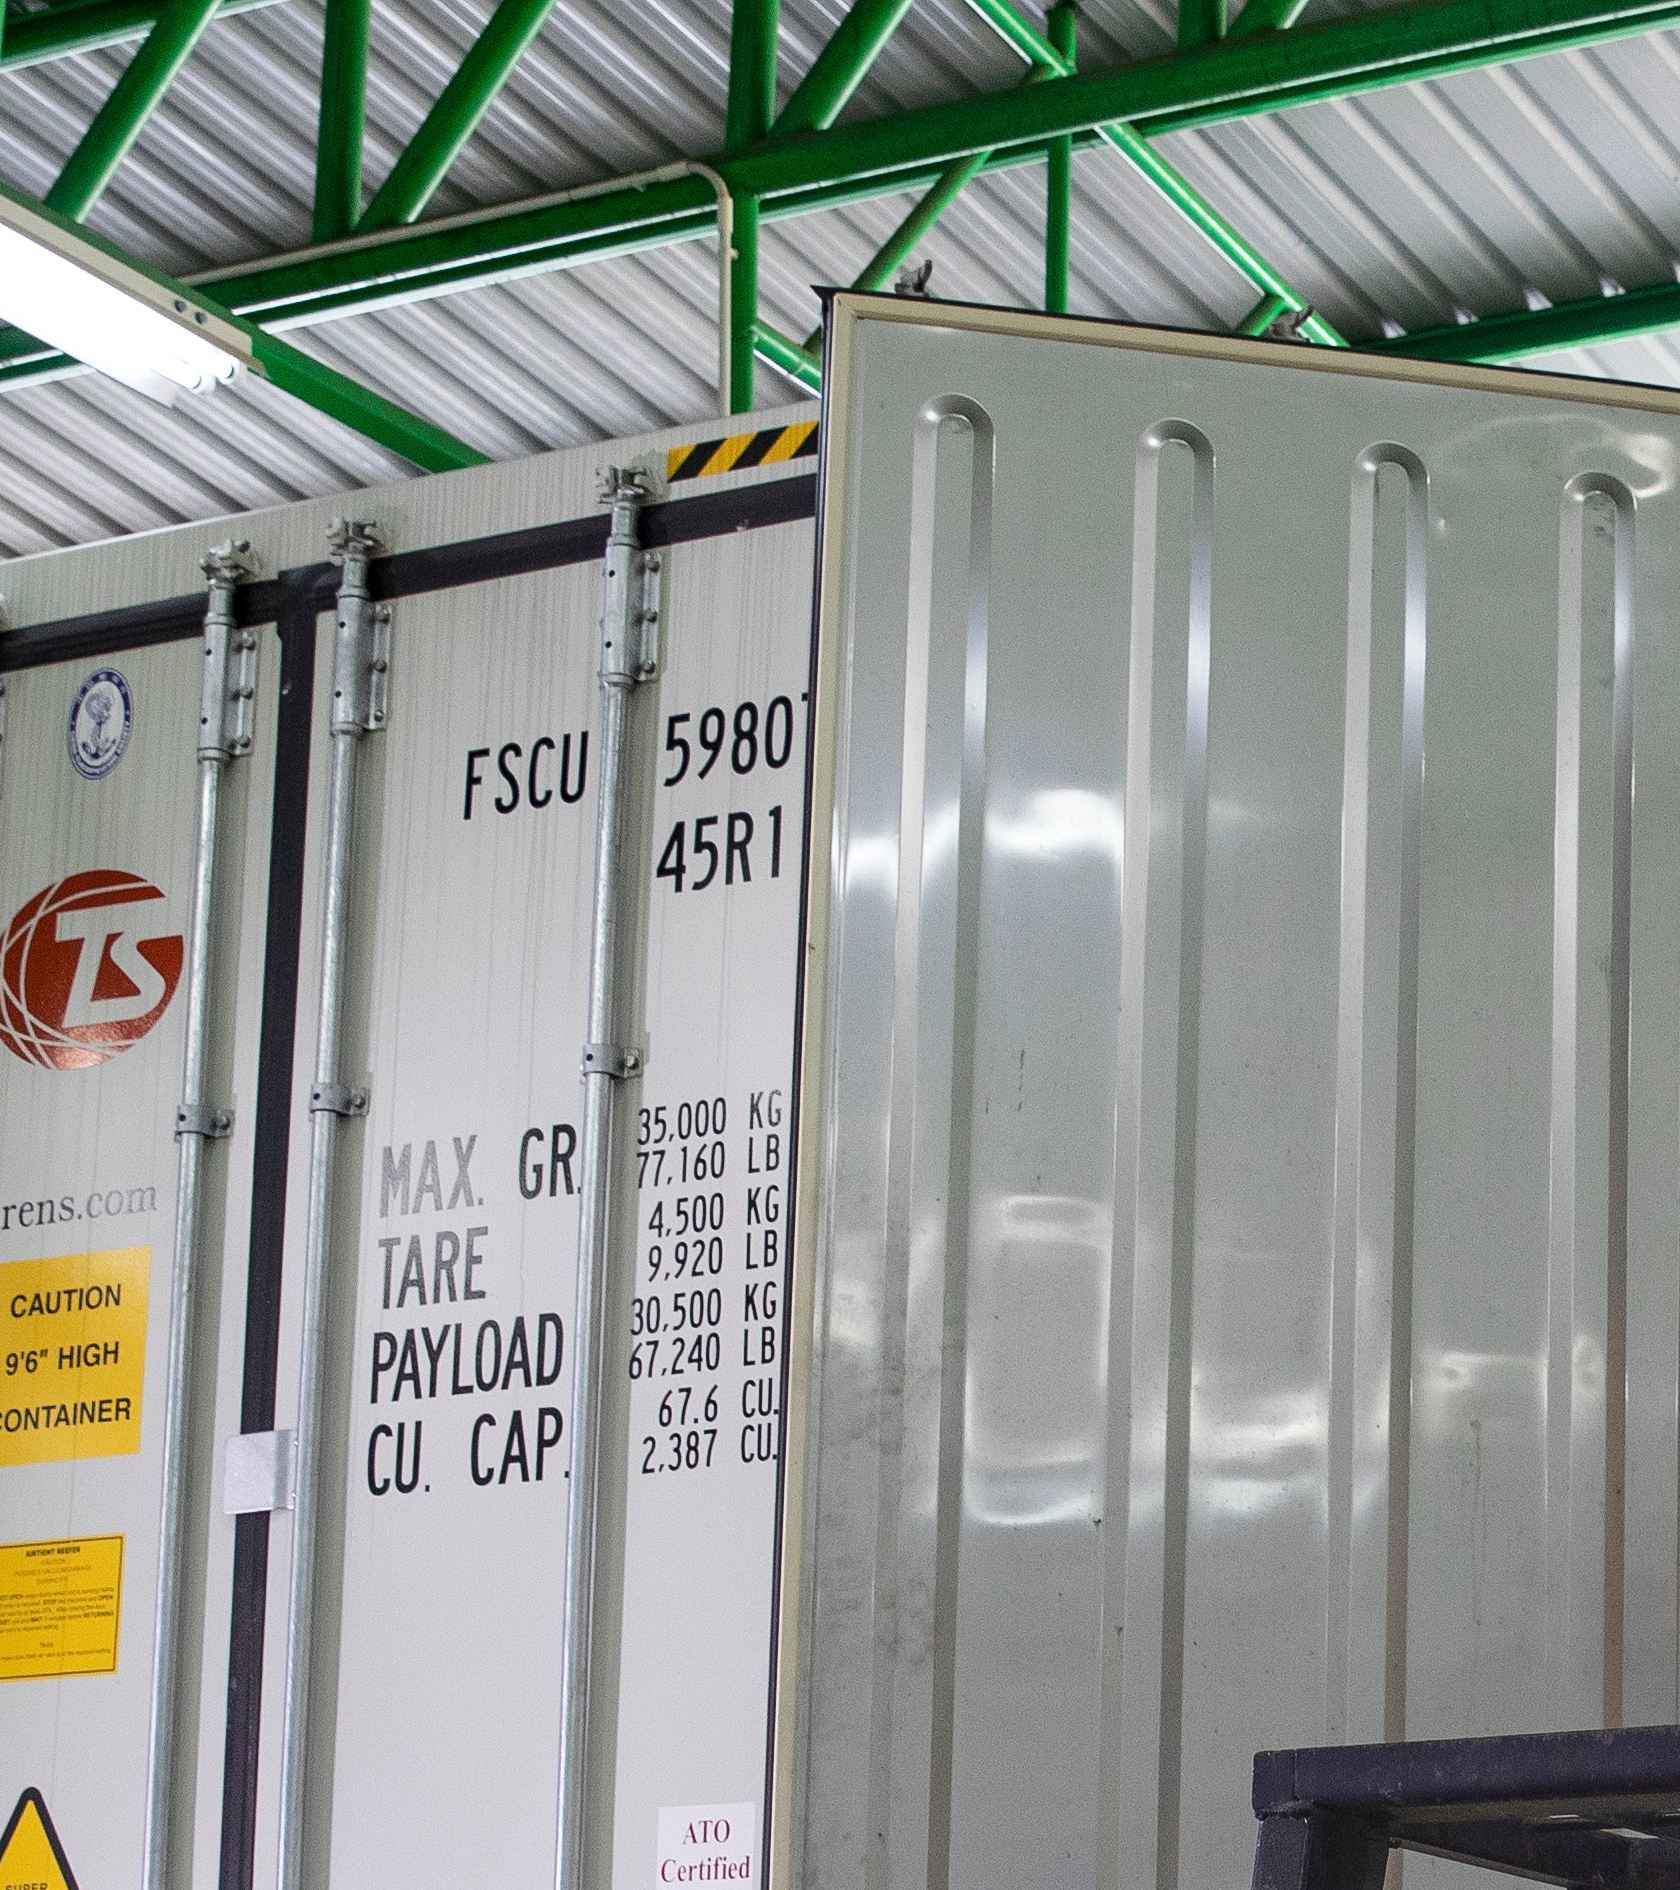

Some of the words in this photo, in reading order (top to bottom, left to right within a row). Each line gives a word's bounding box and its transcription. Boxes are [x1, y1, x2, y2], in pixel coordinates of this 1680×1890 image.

[463, 730, 589, 820] FSCU
[663, 692, 808, 788] 5980
[656, 805, 783, 893] 45R1
[637, 1096, 727, 1146] 35,000
[749, 1089, 782, 1130] KG
[379, 1134, 484, 1218] MAX.
[518, 1123, 582, 1200] GR.
[636, 1140, 726, 1189] 77,160
[748, 1133, 780, 1174] LB
[377, 1226, 489, 1310] TARE
[648, 1192, 724, 1238] 4,500
[747, 1184, 780, 1226] KG
[648, 1236, 723, 1282] 9,920
[745, 1229, 778, 1270] LB
[10, 1284, 122, 1318] CAUTION
[57, 1341, 119, 1371] HIGH
[369, 1312, 564, 1405] PAYLOAD
[630, 1287, 721, 1336] 30,500
[744, 1281, 777, 1322] KG
[629, 1332, 720, 1380] 67,240
[743, 1325, 776, 1366] LB
[367, 1420, 431, 1496] CU.
[470, 1406, 570, 1488] CAP.
[658, 1383, 719, 1427] 67.6
[742, 1377, 779, 1418] CU.
[641, 1428, 718, 1474] 2,387
[741, 1422, 778, 1463] CU.
[682, 1818, 731, 1845] ATO
[660, 1855, 750, 1883] Certified
